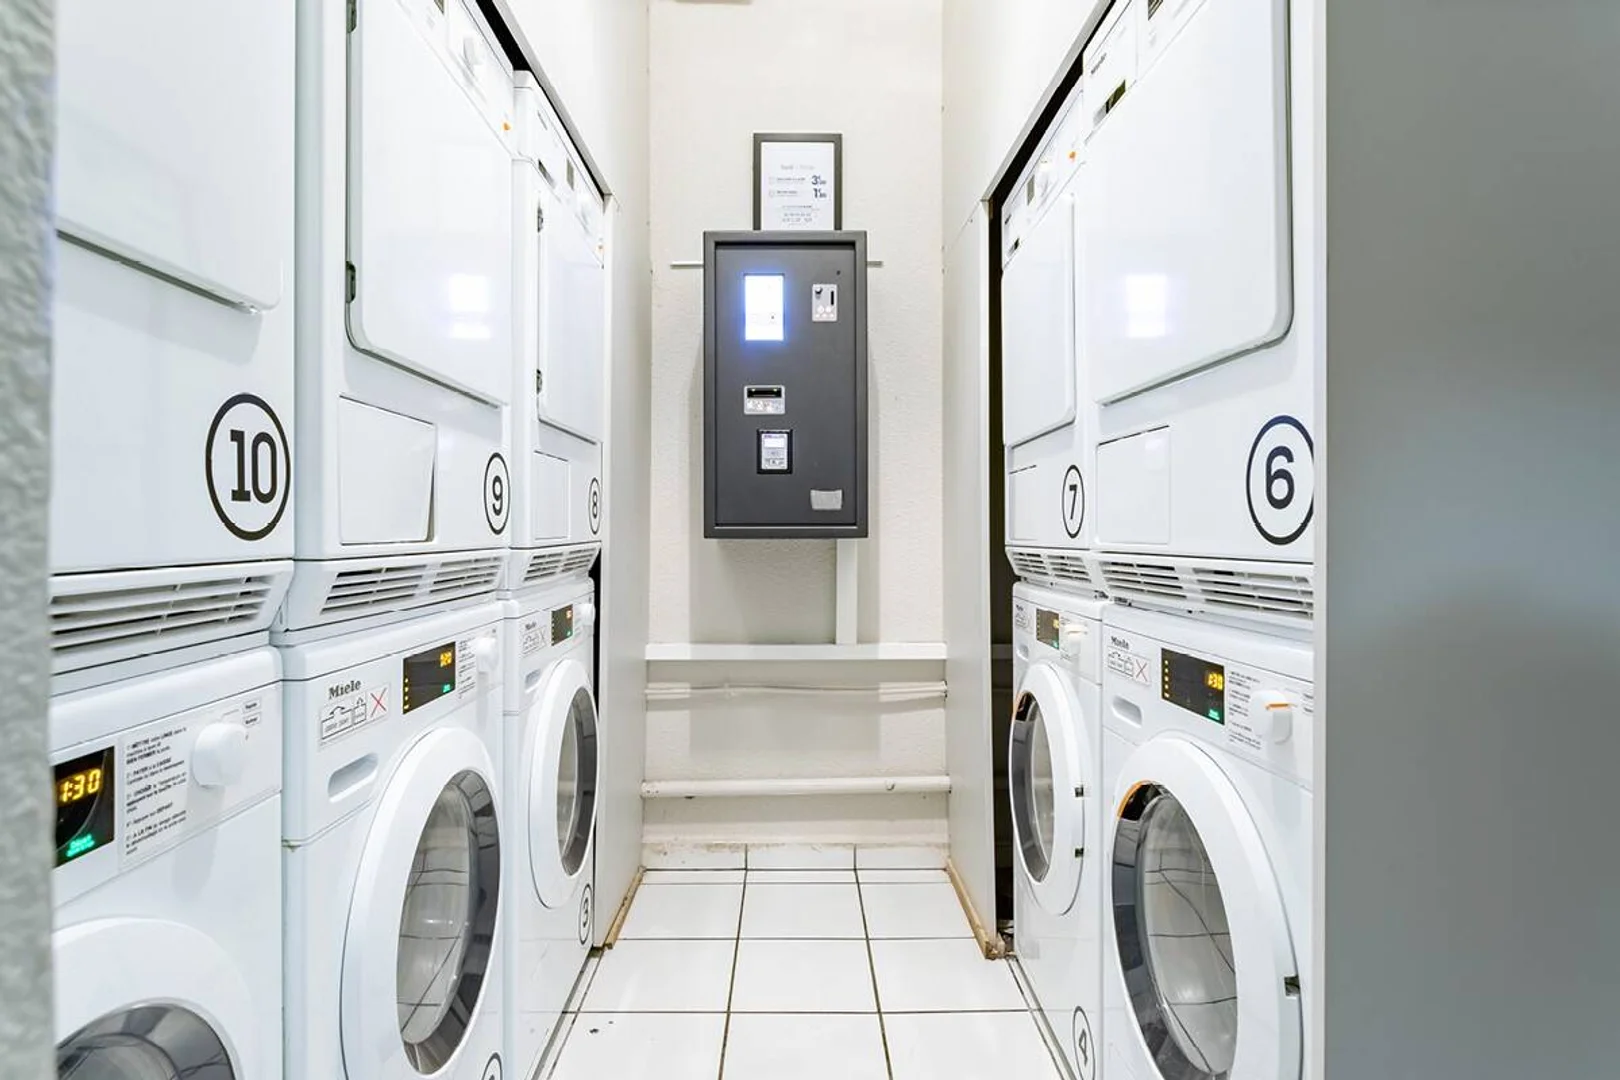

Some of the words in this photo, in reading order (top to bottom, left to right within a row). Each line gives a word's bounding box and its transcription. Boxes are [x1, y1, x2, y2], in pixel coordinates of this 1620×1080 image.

[229, 428, 278, 504] 10
[1265, 445, 1295, 510] 6
[492, 475, 503, 516] 9
[591, 490, 598, 519] 8
[1069, 484, 1078, 520] 7
[328, 680, 362, 700] Miele
[62, 768, 102, 803] 1:30
[582, 896, 589, 929] 3
[1078, 1027, 1089, 1069] 4
